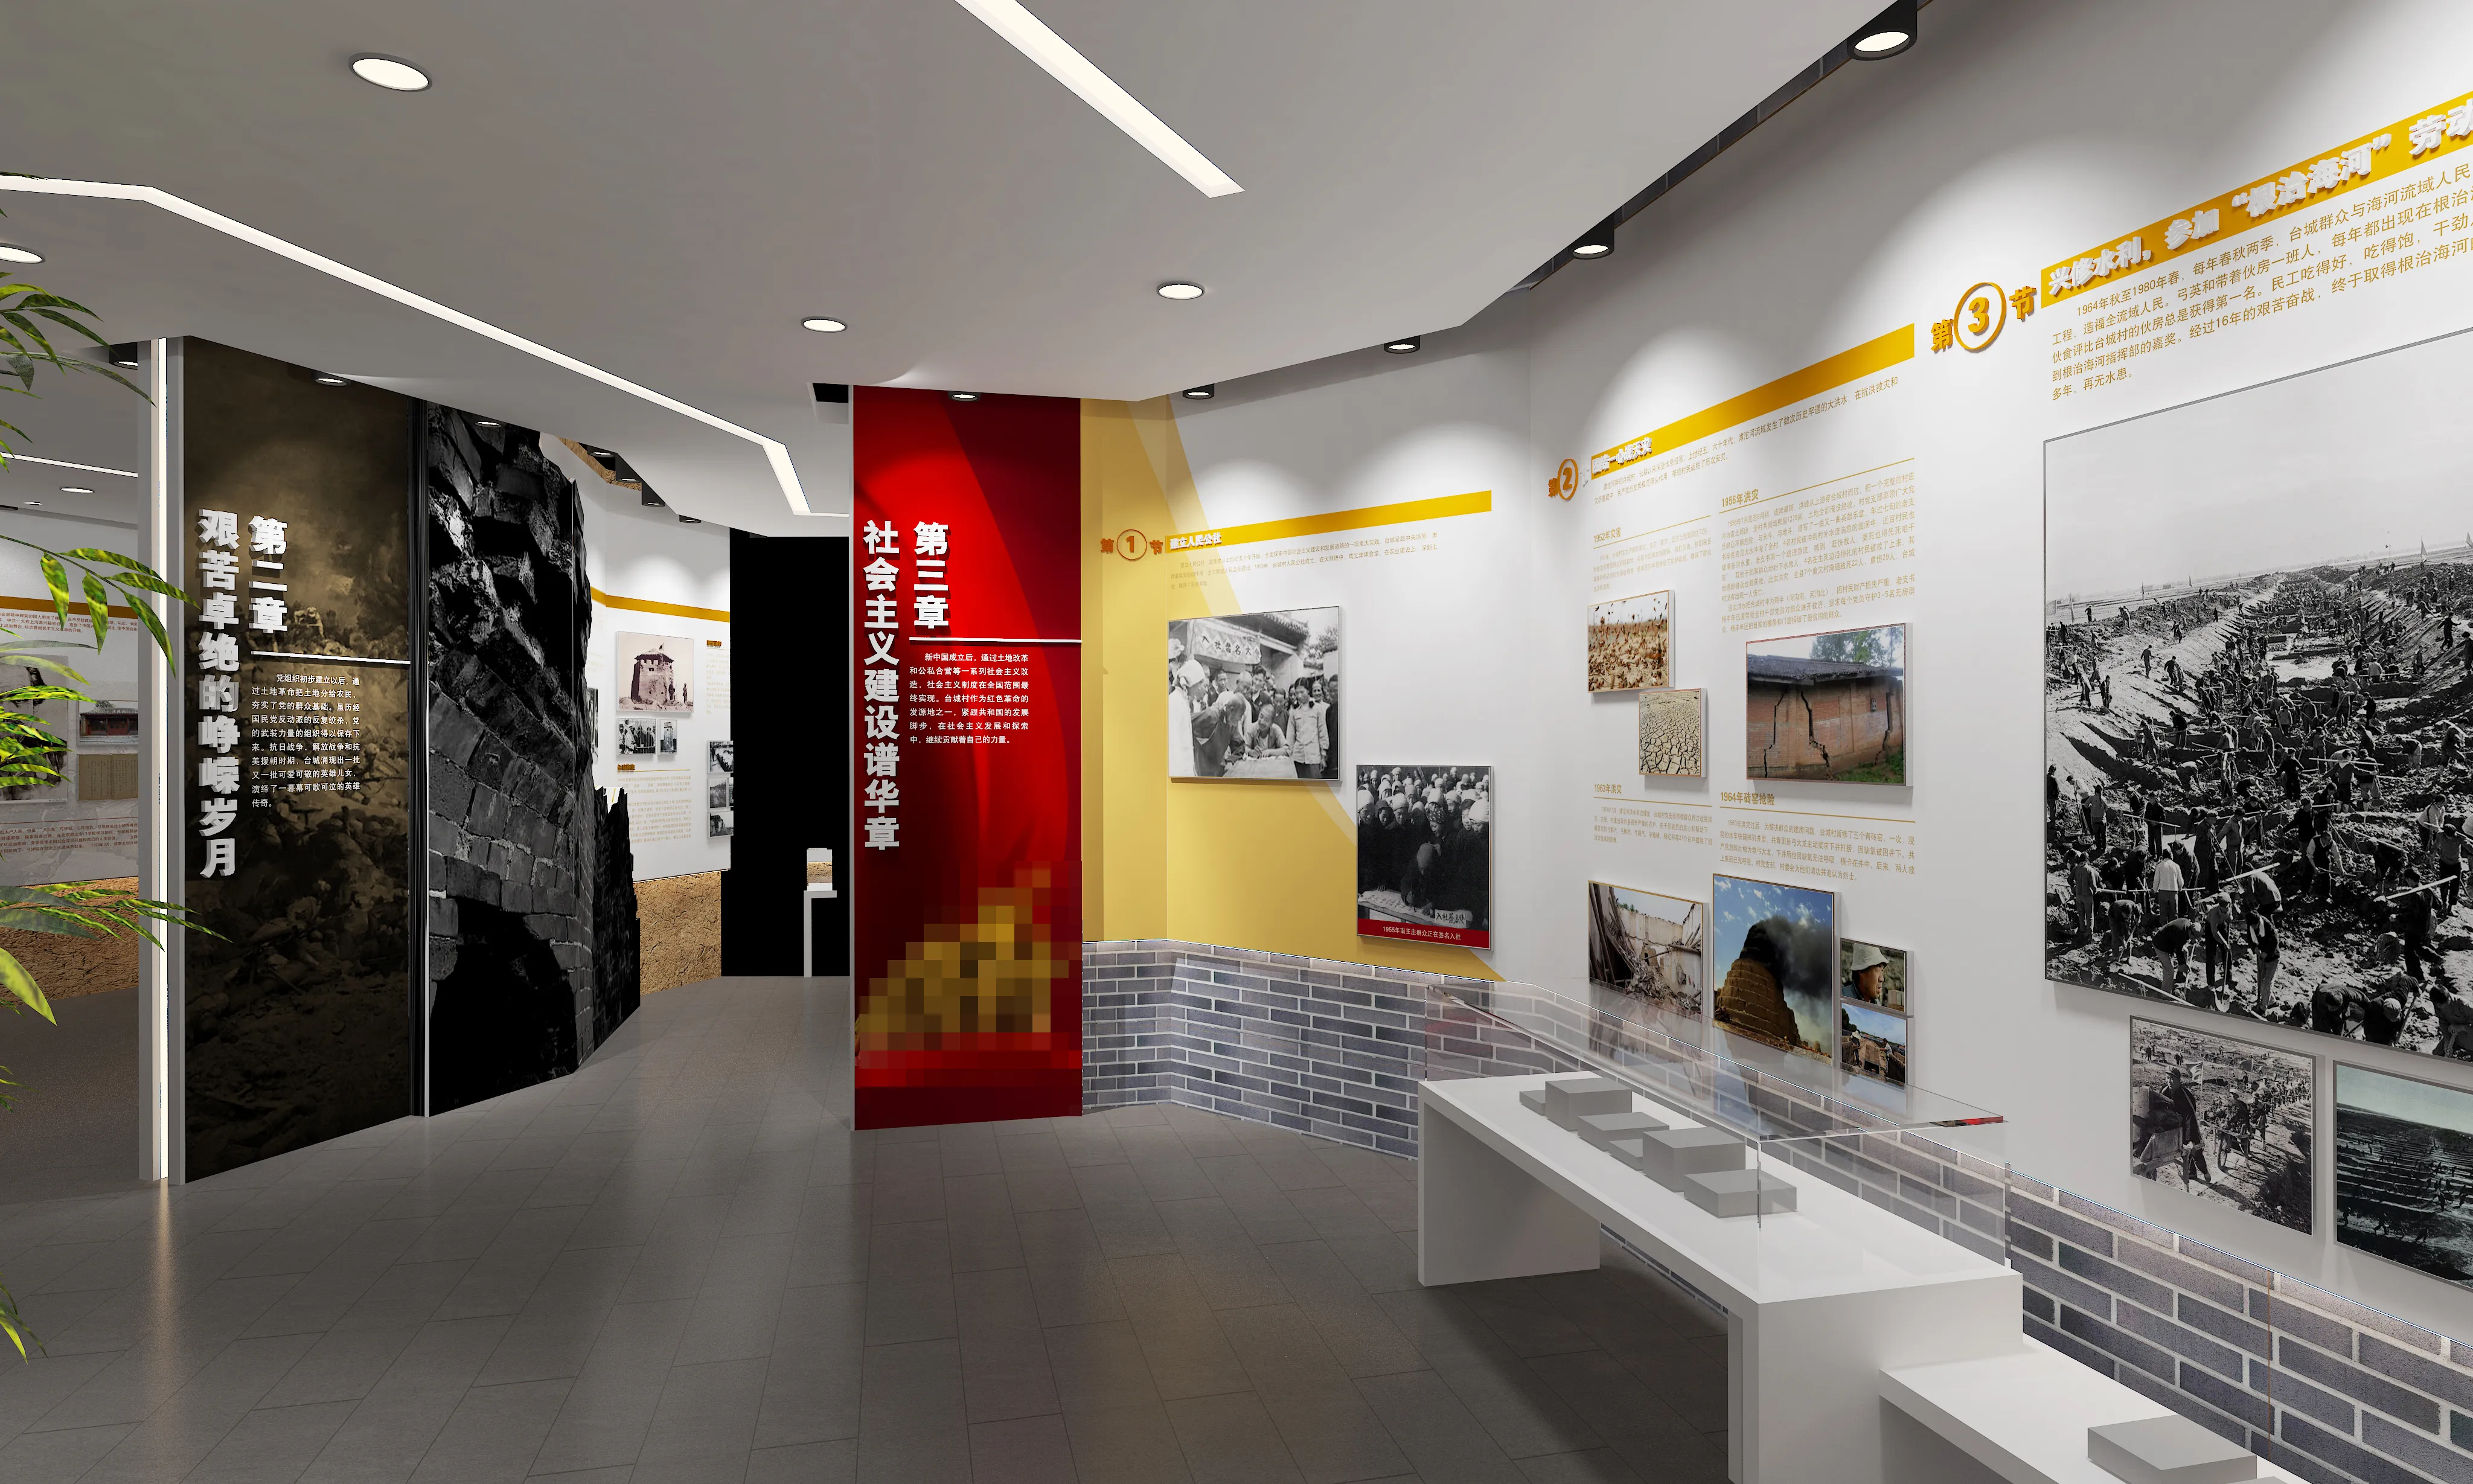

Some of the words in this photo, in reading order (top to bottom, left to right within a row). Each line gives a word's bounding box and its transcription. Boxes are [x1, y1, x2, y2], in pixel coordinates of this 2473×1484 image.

[2052, 185, 2473, 345] 工程，造福全流域人民。弓英和带着伙房一班人，每年都出现在根治
[2052, 211, 2473, 363] 伙食评比台城村的伙房总是获得第一名。民工吃得好，吃得饱，干劲
[2052, 367, 2132, 400] 多年，再无水患。
[1722, 489, 1759, 507] 1956年洪灾
[1593, 527, 1621, 543] 1952年灾害
[1170, 532, 1223, 550] 建立人民公社
[249, 516, 287, 634] 第二章
[914, 521, 949, 629] 第三章
[924, 653, 1029, 662] 新中国成立后，通过土地改革
[909, 667, 1029, 676] 和公私合营等一系列社会主义改
[276, 673, 360, 686] 党组织初步建立以后，通
[863, 520, 900, 850] 社会主义建设谱华章
[909, 680, 1029, 690] 造，社会主义制度在全国范围最
[198, 508, 240, 878] 艰苦卓绝的峥嵘岁月
[252, 686, 356, 699] 过土地革命把土地分给农民，
[909, 694, 1029, 703] 终实现。台城村作为红色革命的
[252, 701, 360, 712] 夯实了党的群众基础。虽历经
[909, 708, 1029, 717] 发源地之一，紧跟共和国的发展
[252, 714, 360, 725] 国民党反动派的反复绞杀，党
[909, 721, 1029, 731] 脚步，在社会主义发展和探索
[252, 728, 360, 738] 的武装力量的组织得以保存下
[909, 735, 1010, 745] 中，继续贡献着自己的力量。
[252, 742, 360, 752] 来。抗日战争、解放战争和抗
[252, 756, 360, 766] 美援朝时期，台城涌现出一批
[252, 769, 356, 779] 又一批可爱可敬的英雄儿女，
[252, 782, 360, 794] 演绎了一幕幕可歌可泣的英雄
[1594, 784, 1622, 794] 1963年洪灾
[252, 799, 273, 808] 传奇。
[1720, 792, 1775, 805] 1964年砖窑抢险
[1383, 926, 1461, 940] 1955年南王庄群众正在签名入社
